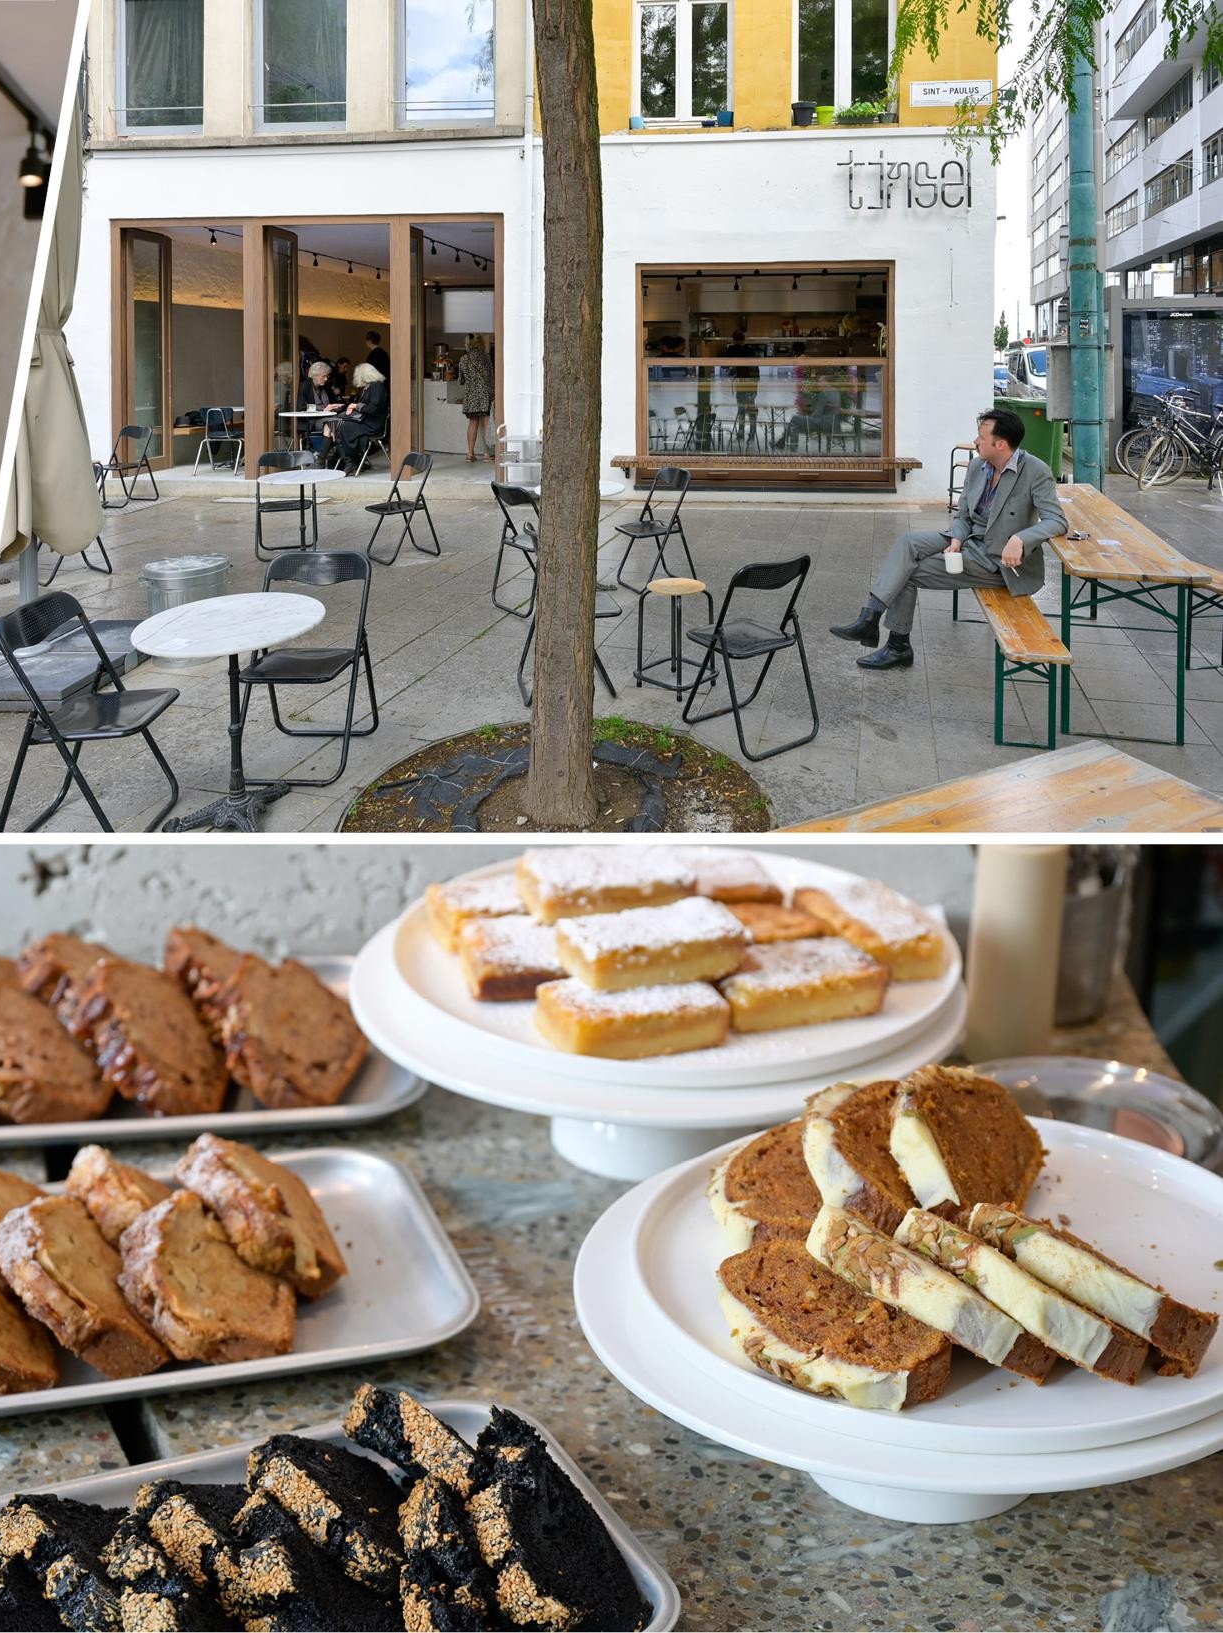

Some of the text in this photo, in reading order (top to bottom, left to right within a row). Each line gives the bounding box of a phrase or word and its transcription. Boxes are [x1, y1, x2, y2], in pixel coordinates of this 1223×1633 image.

[923, 87, 941, 96] SINT
[949, 86, 980, 95] PAULUS
[837, 149, 973, 209] tinsel
